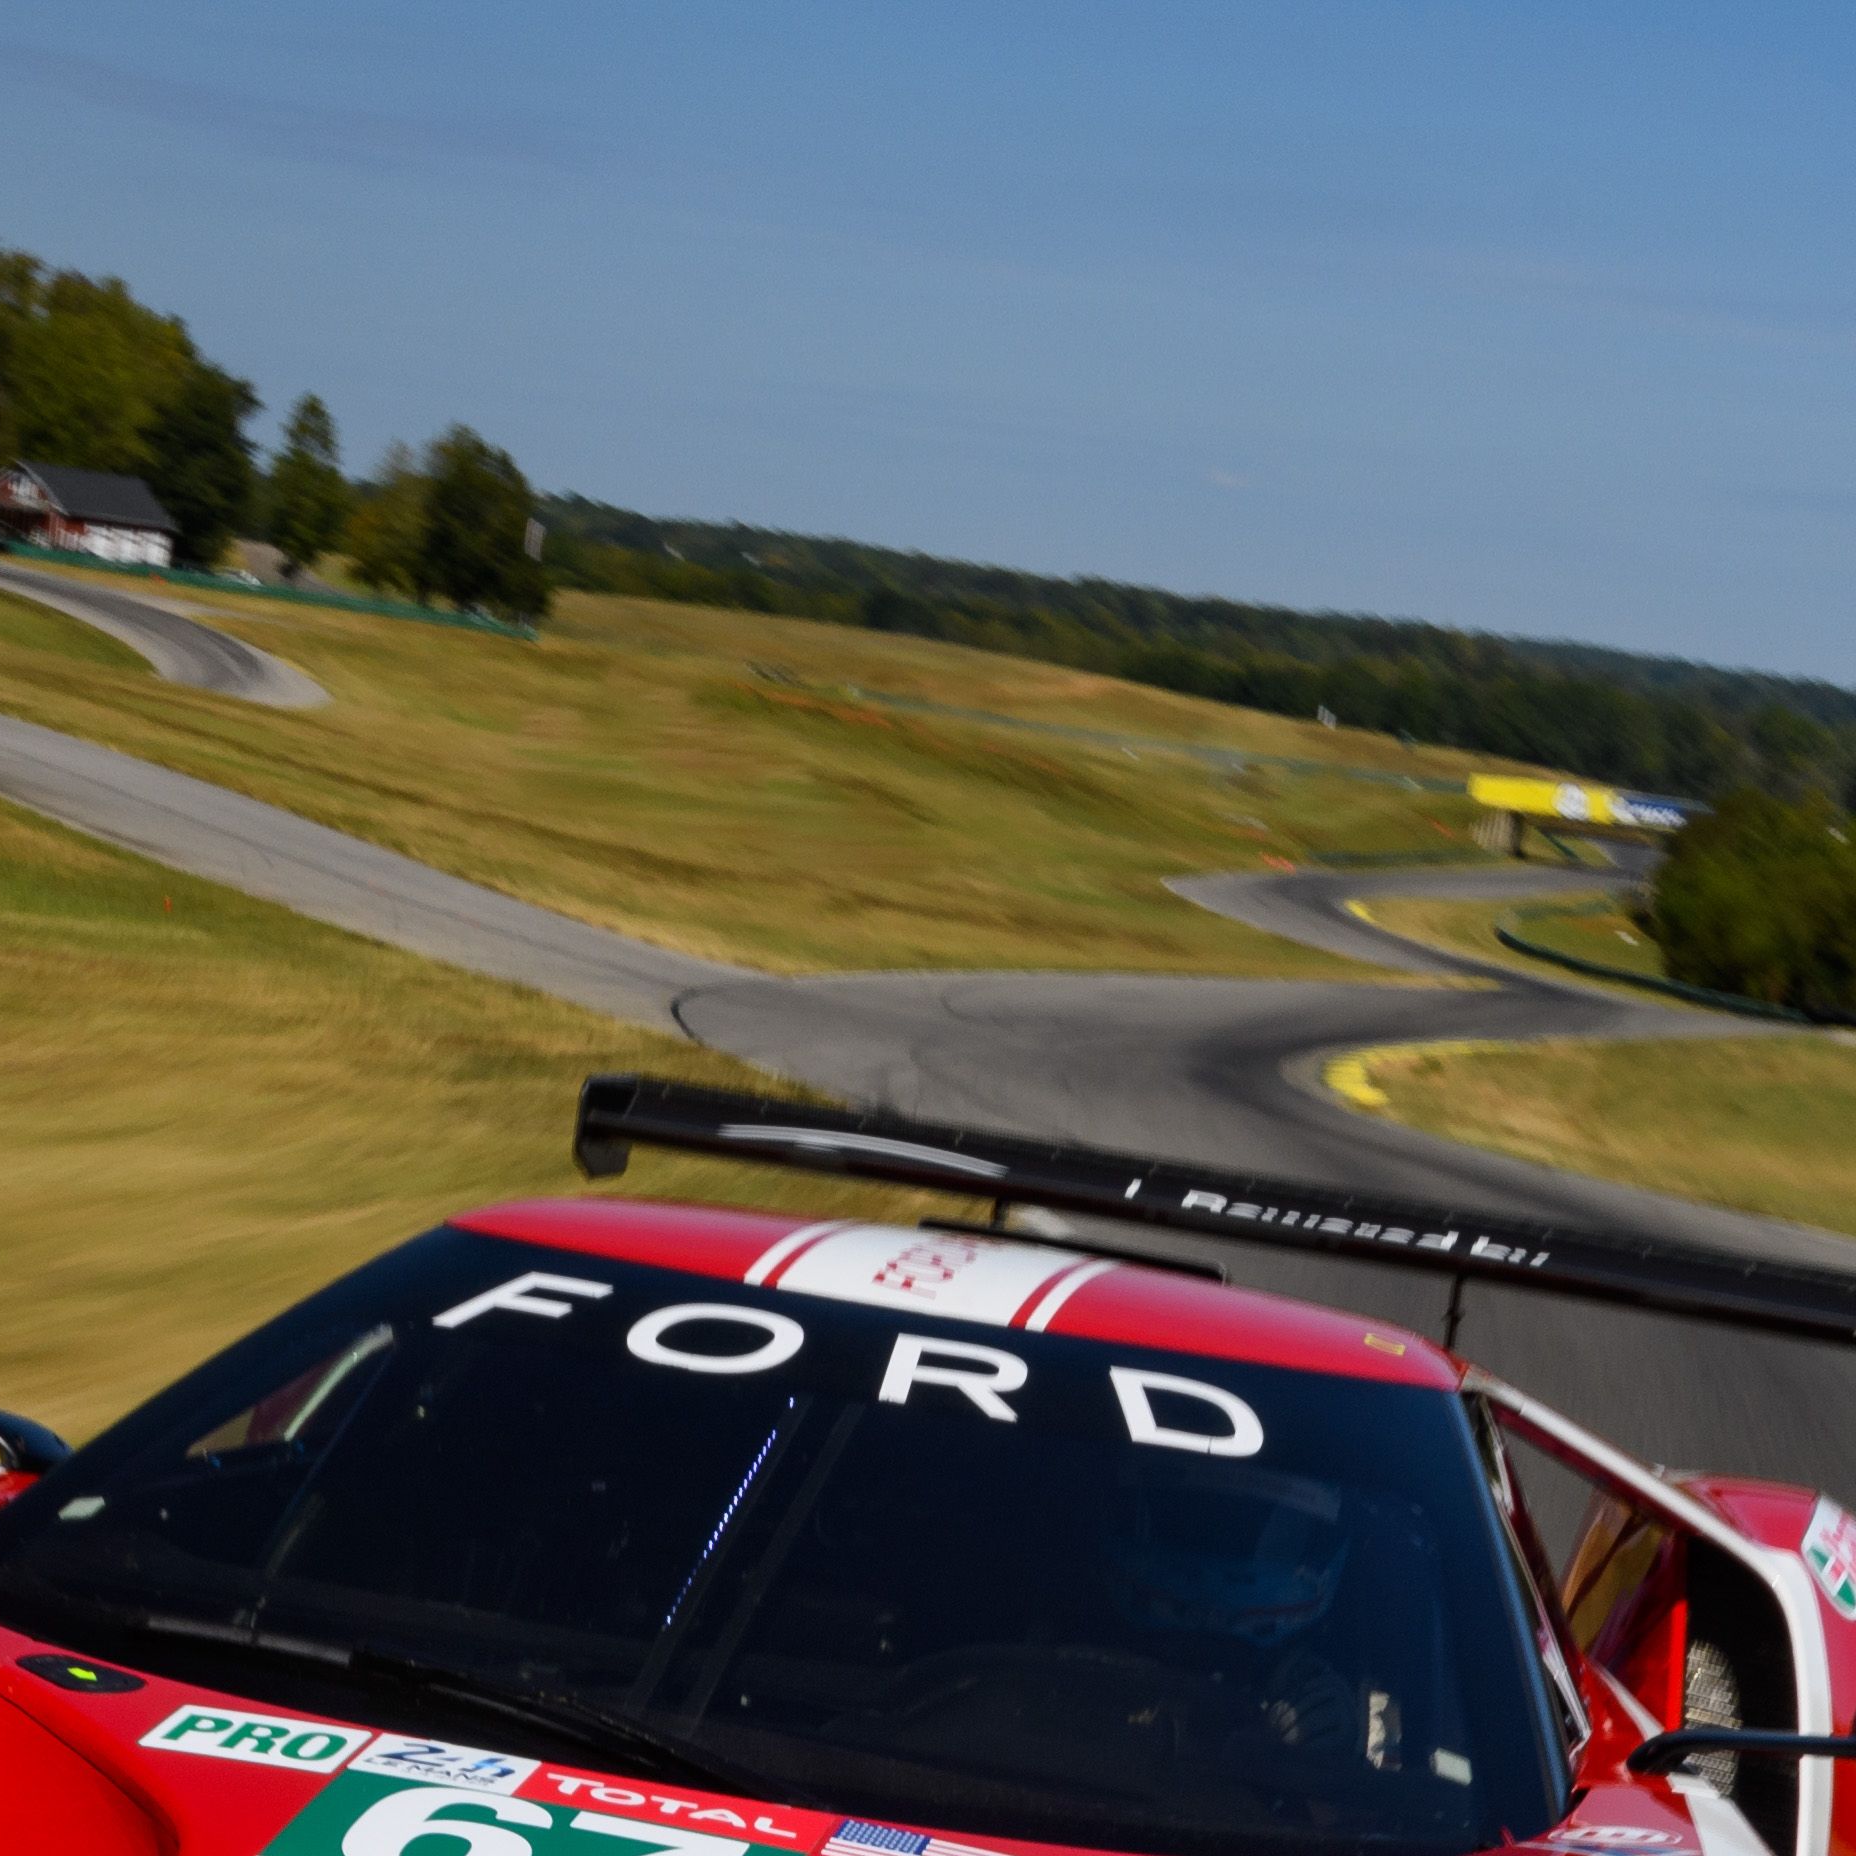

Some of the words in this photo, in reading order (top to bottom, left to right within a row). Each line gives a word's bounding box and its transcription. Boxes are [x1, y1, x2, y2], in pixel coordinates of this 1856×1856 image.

[431, 1270, 1266, 1458] FORD
[159, 1713, 349, 1762] PRO
[547, 1773, 798, 1840] TOTAL
